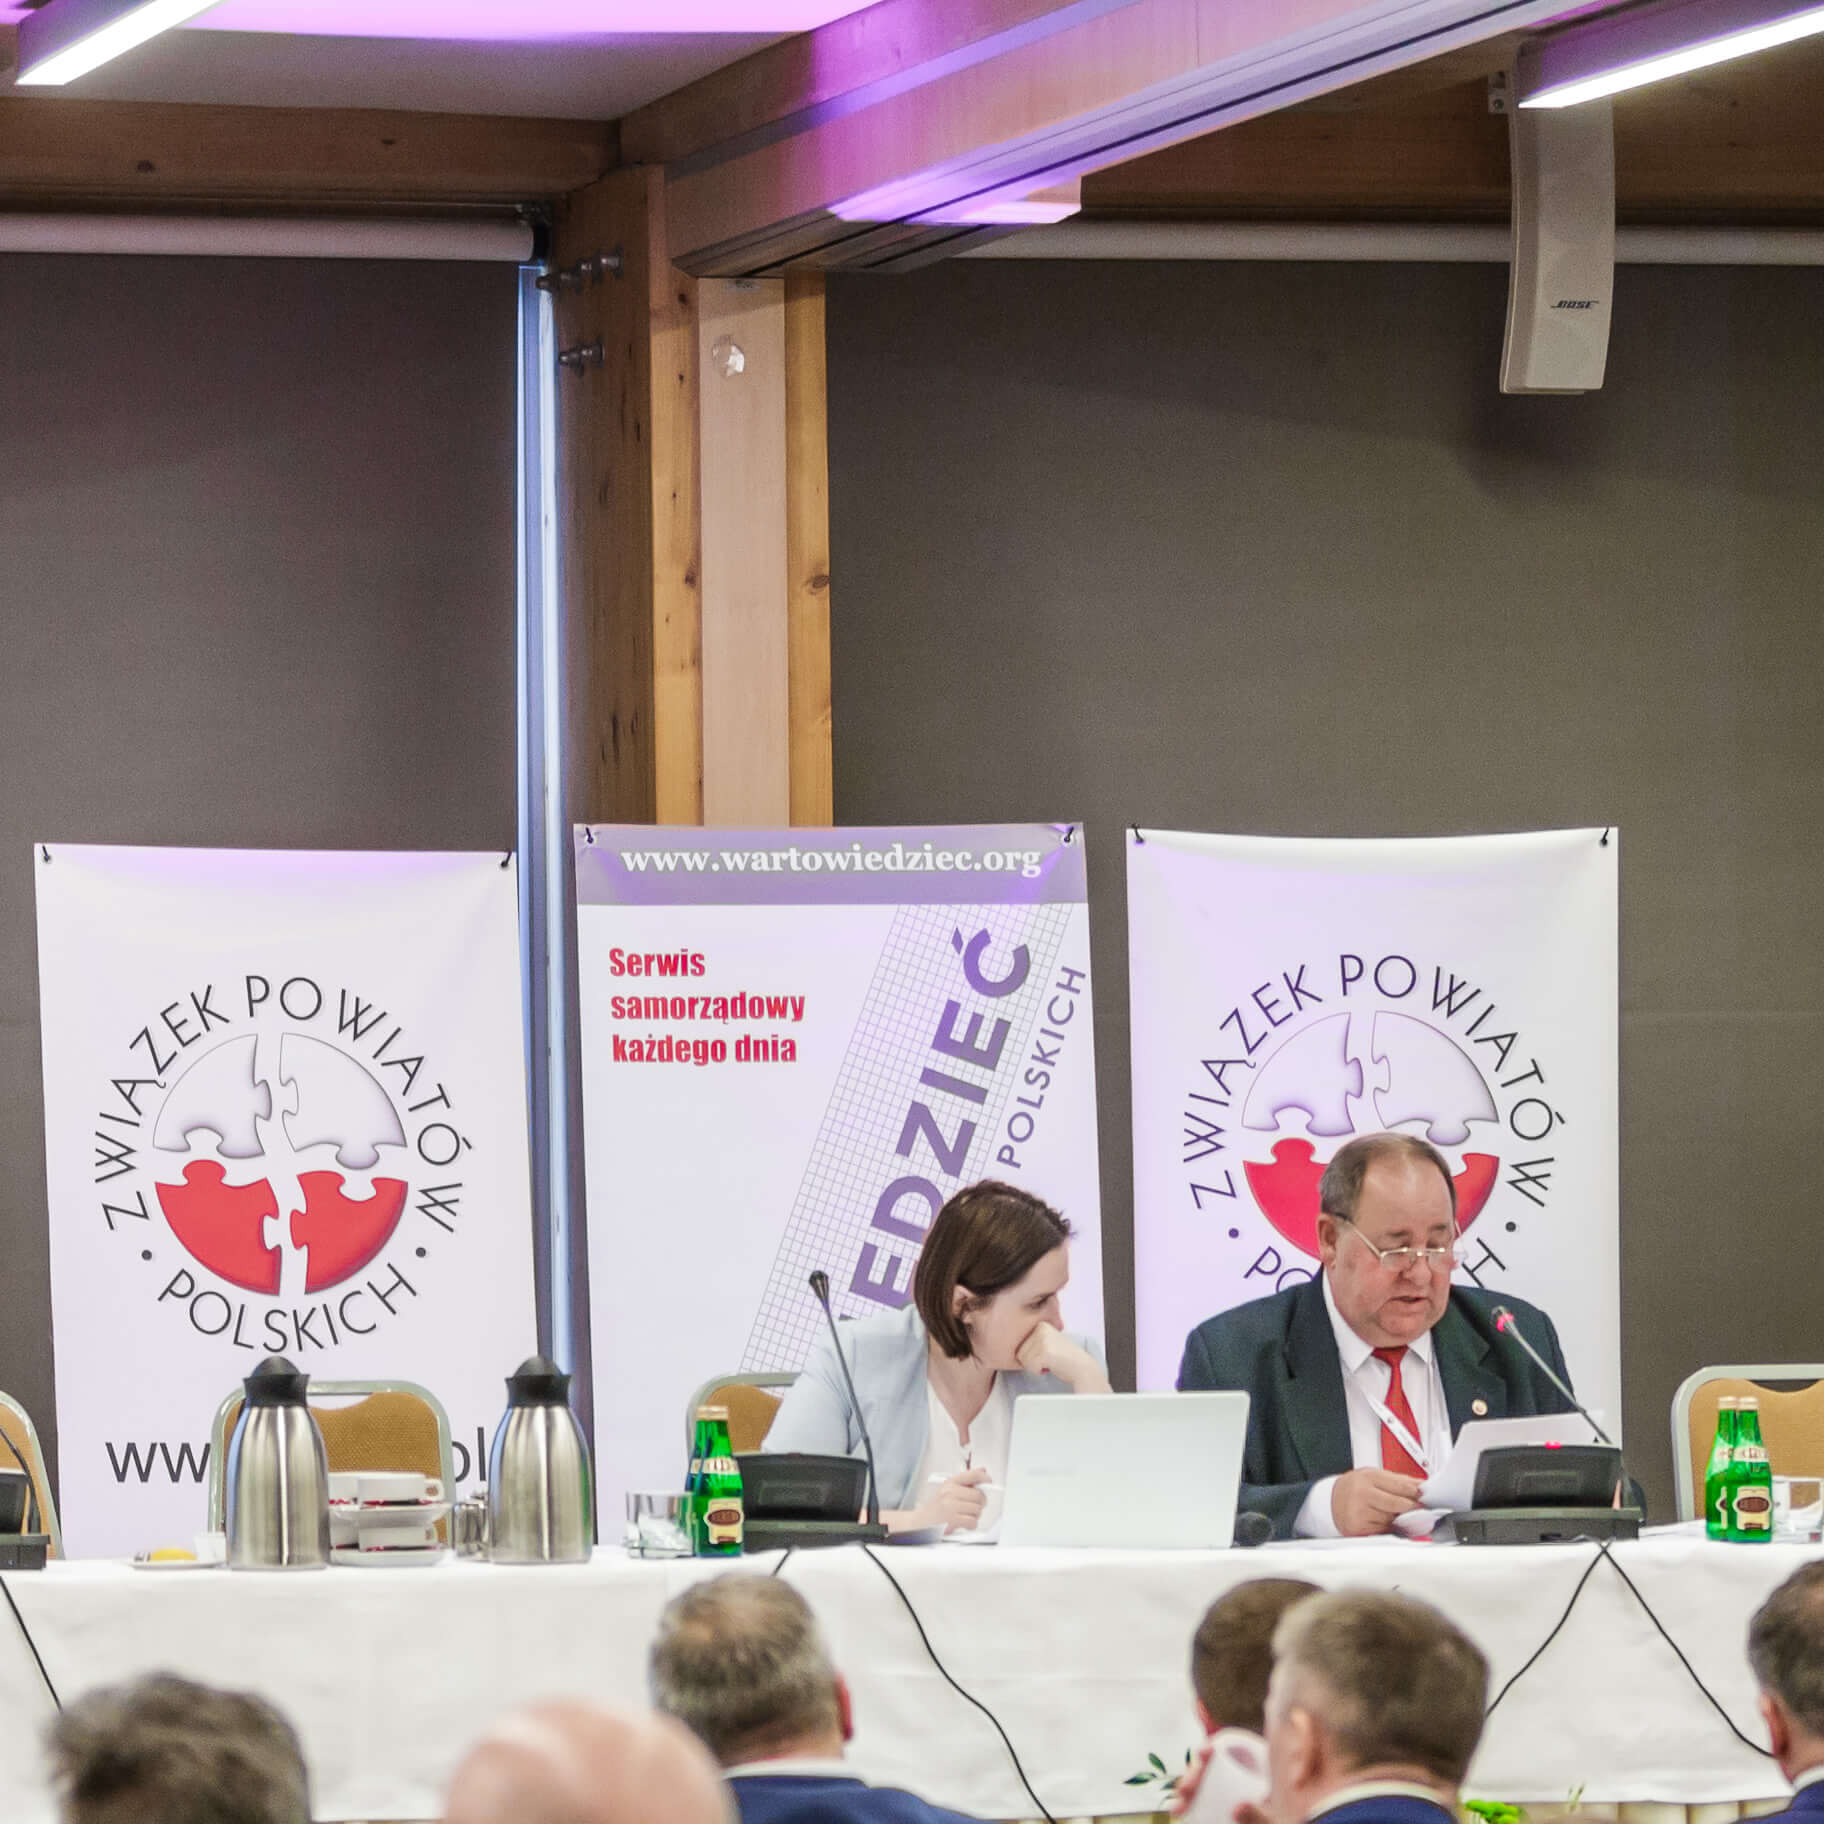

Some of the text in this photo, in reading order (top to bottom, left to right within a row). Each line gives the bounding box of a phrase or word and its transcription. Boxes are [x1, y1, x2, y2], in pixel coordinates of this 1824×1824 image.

[620, 842, 1043, 879] www.wartowiedziec.org
[608, 947, 706, 977] Serwis
[610, 991, 805, 1024] samorządowy
[612, 1033, 797, 1067] każdego dnia
[996, 965, 1086, 1169] POLSKICH
[1183, 954, 1565, 1210] ZWIĄZEK POWIATÓW
[95, 975, 473, 1233] ZWIĄZEK POWIATÓW
[839, 926, 1032, 1320] EDZIEĆ
[157, 1262, 418, 1353] POLSKICH
